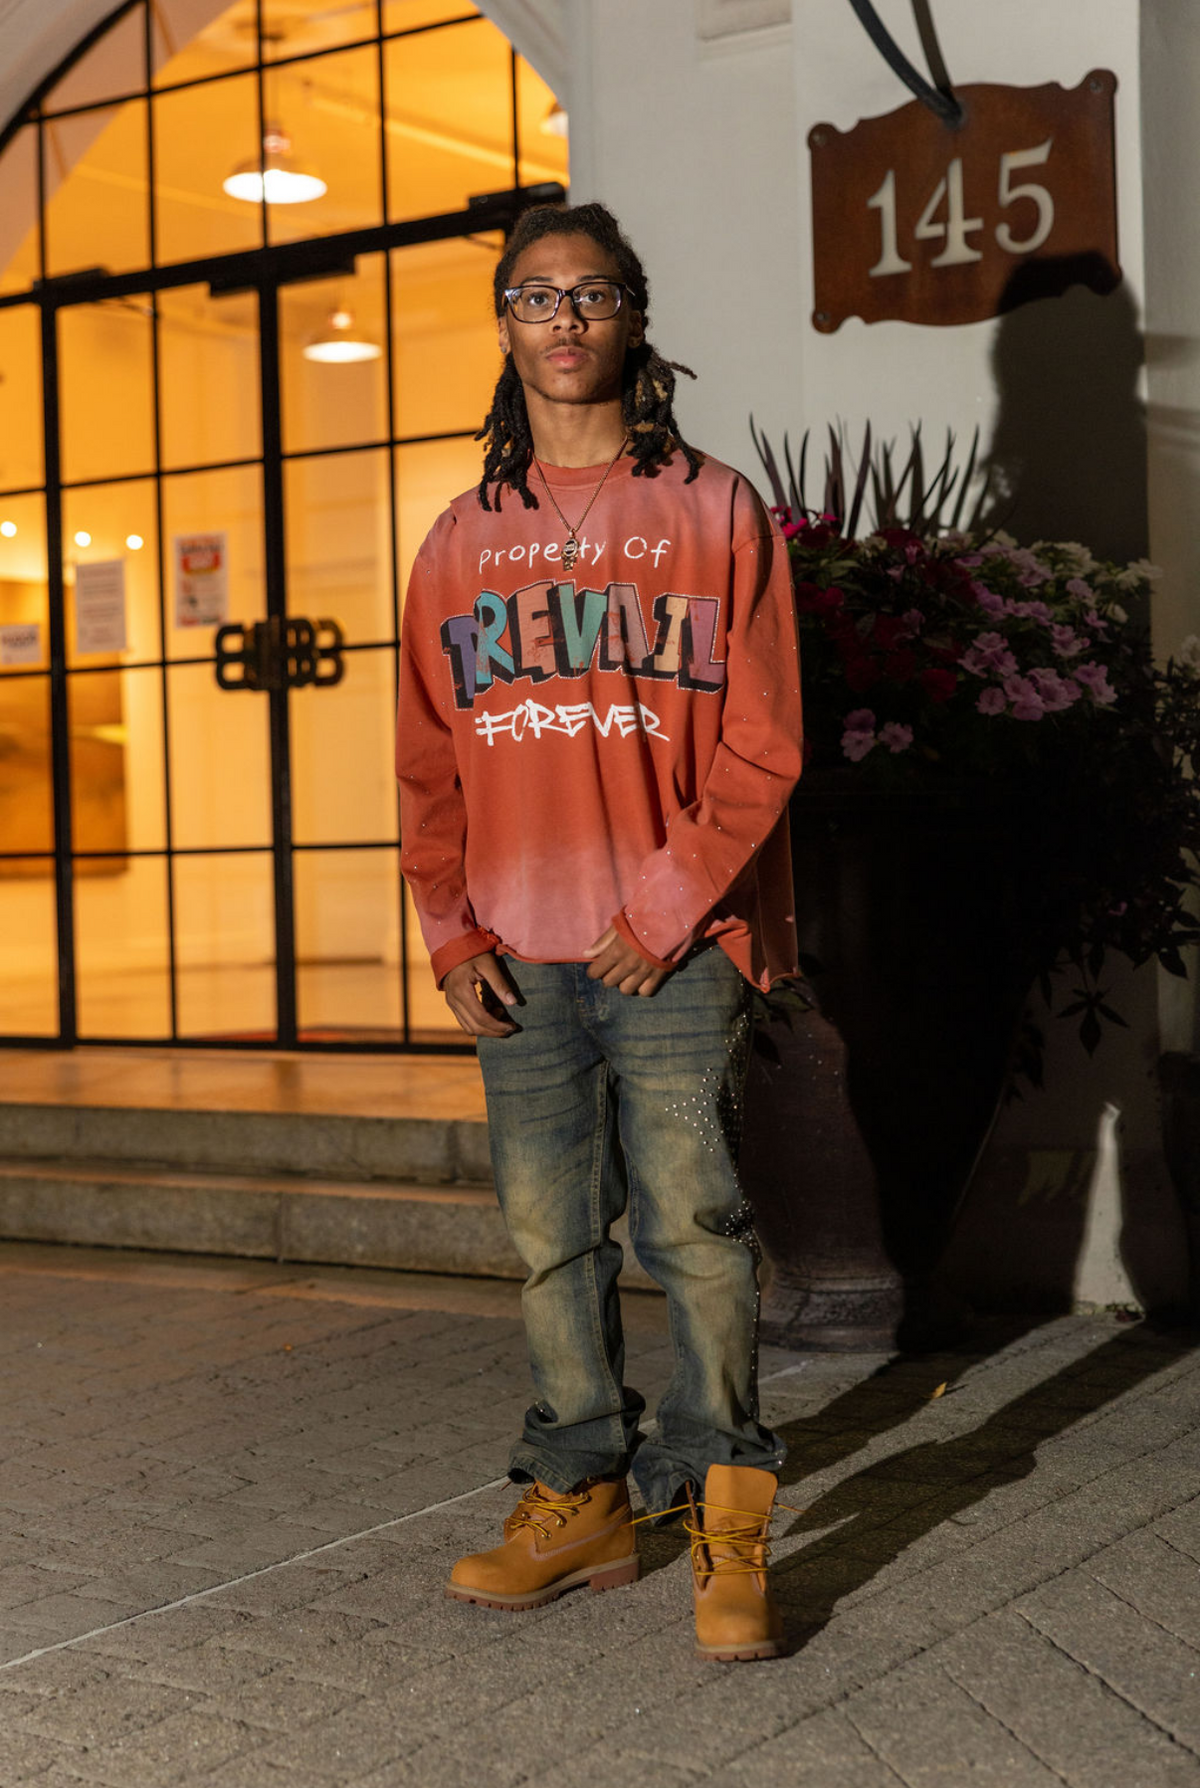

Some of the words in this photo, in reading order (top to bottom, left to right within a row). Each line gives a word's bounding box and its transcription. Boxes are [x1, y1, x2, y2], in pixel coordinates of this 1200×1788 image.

[867, 138, 1054, 277] 145
[479, 537, 606, 574] propety
[624, 537, 671, 568] Of
[475, 699, 670, 746] FOREVER
